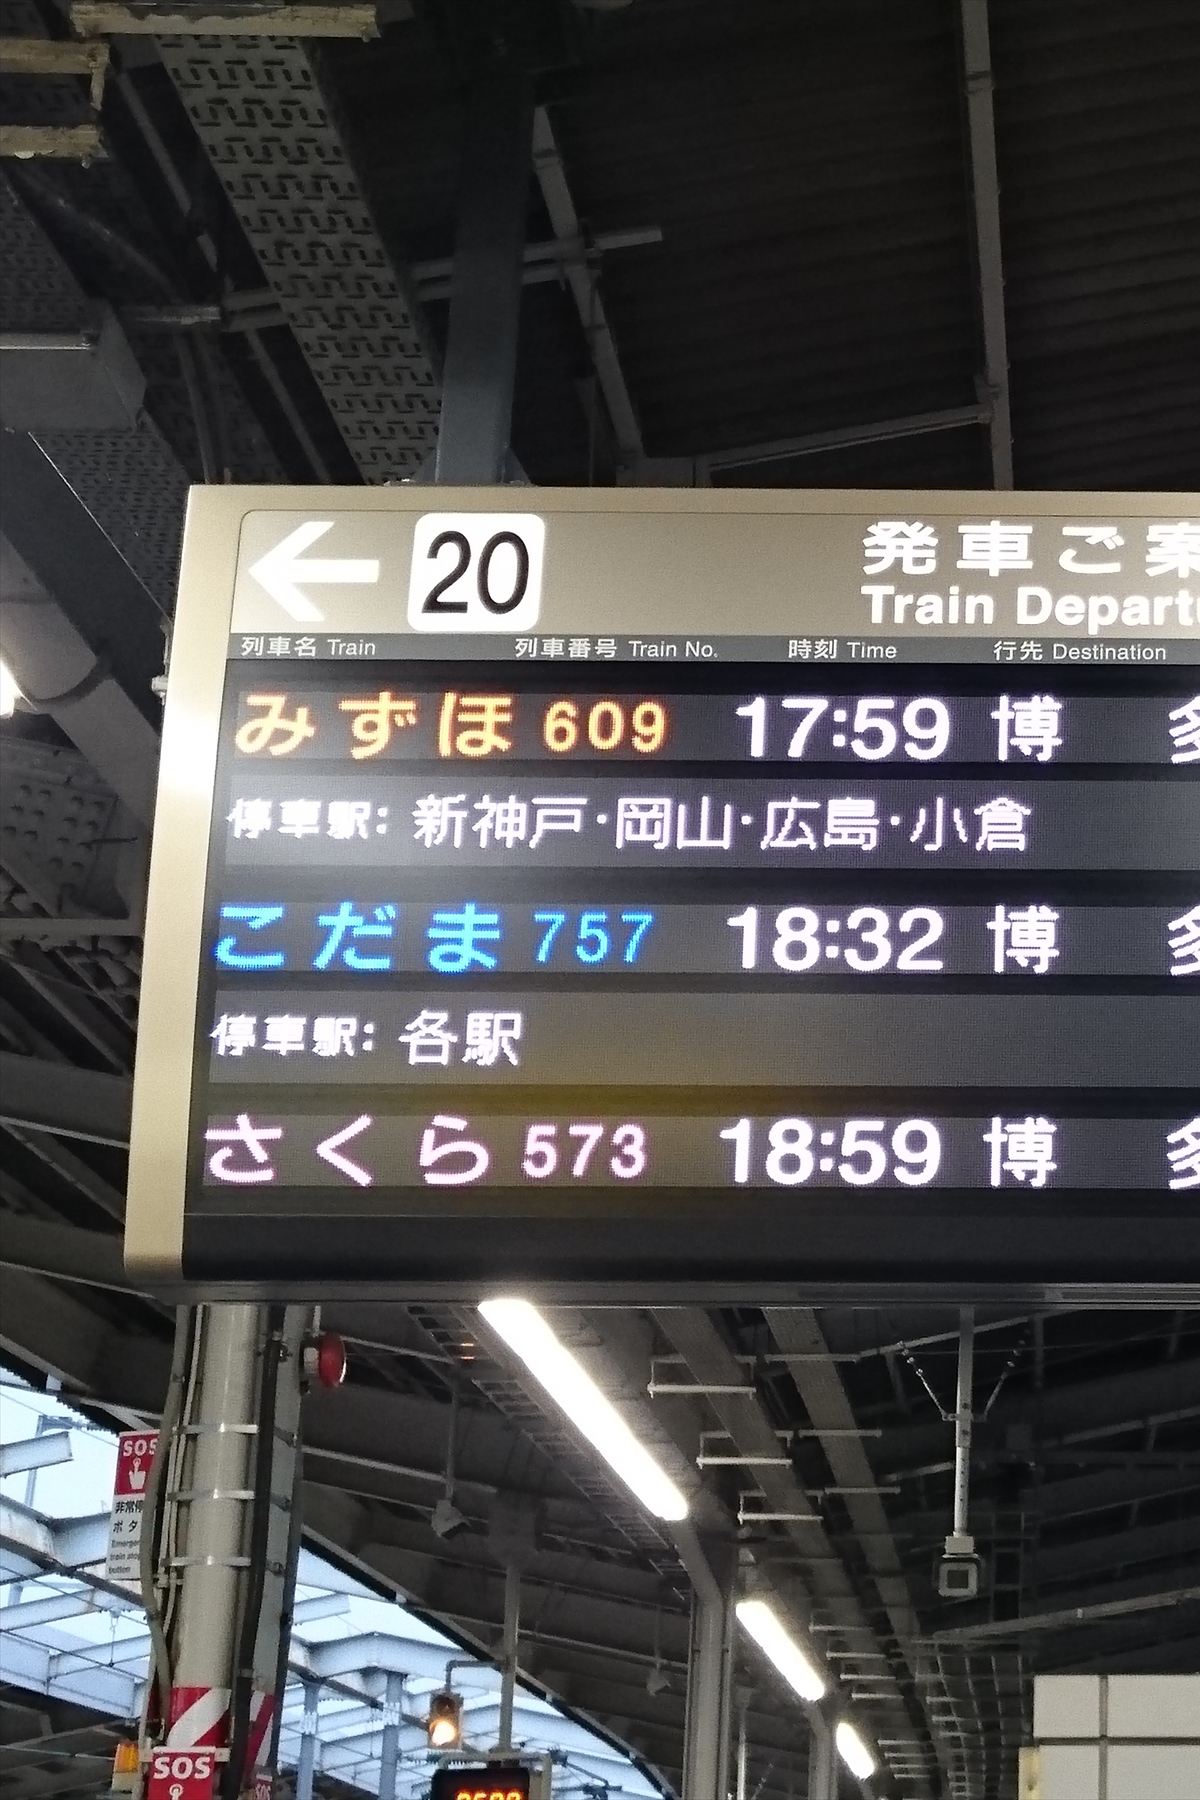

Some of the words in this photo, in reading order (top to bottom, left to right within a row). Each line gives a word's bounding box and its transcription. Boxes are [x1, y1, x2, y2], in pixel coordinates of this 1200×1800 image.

[421, 530, 529, 615] 20
[860, 585, 994, 627] Train
[241, 636, 317, 657] 列車名
[328, 639, 376, 656] Train
[515, 638, 617, 659] 列車番号
[629, 640, 677, 658] Train
[686, 641, 718, 658] No.
[788, 640, 837, 660] 時刻
[847, 642, 897, 660] Time
[994, 641, 1043, 661] 行先
[1053, 643, 1166, 660] Destination
[235, 691, 513, 760] みずほ
[544, 701, 665, 753] 609
[735, 696, 950, 760] 17:59
[214, 902, 500, 974] こだま
[534, 912, 655, 963] 757
[727, 906, 944, 972] 18:32
[399, 1010, 522, 1066] 各駅
[204, 1113, 489, 1187] さくら
[523, 1124, 646, 1179] 573
[720, 1118, 940, 1186] 18:59
[123, 1438, 158, 1457] SOS
[153, 1756, 211, 1780] SOS
